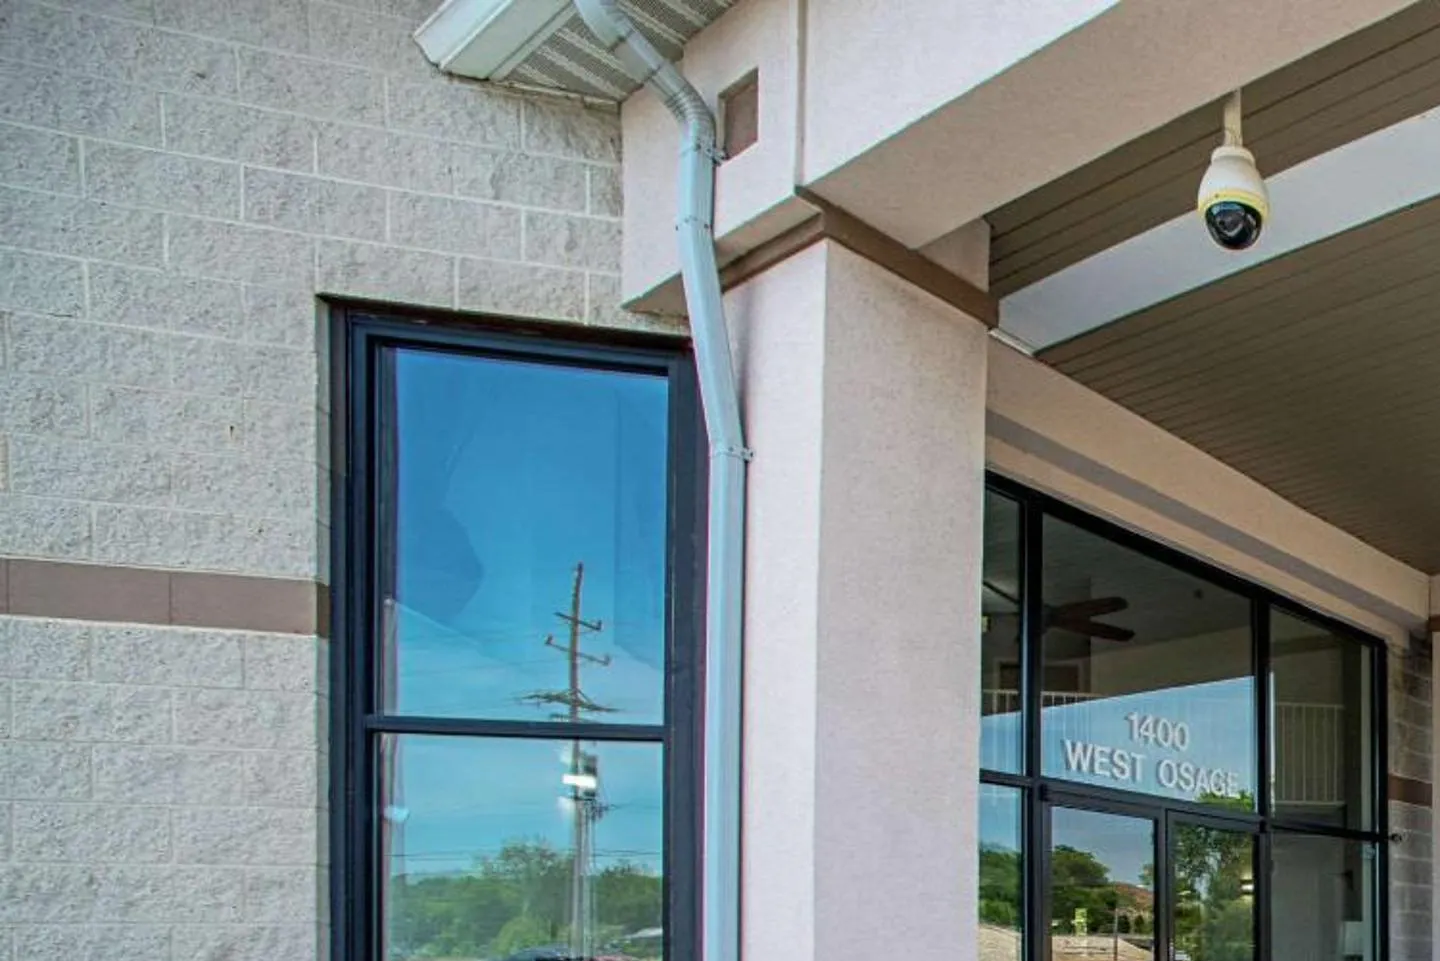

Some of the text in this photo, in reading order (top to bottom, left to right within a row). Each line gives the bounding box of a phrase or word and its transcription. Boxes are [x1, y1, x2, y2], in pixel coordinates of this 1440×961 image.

[1127, 712, 1189, 751] 1400
[1064, 739, 1240, 797] WEST OSAGE
